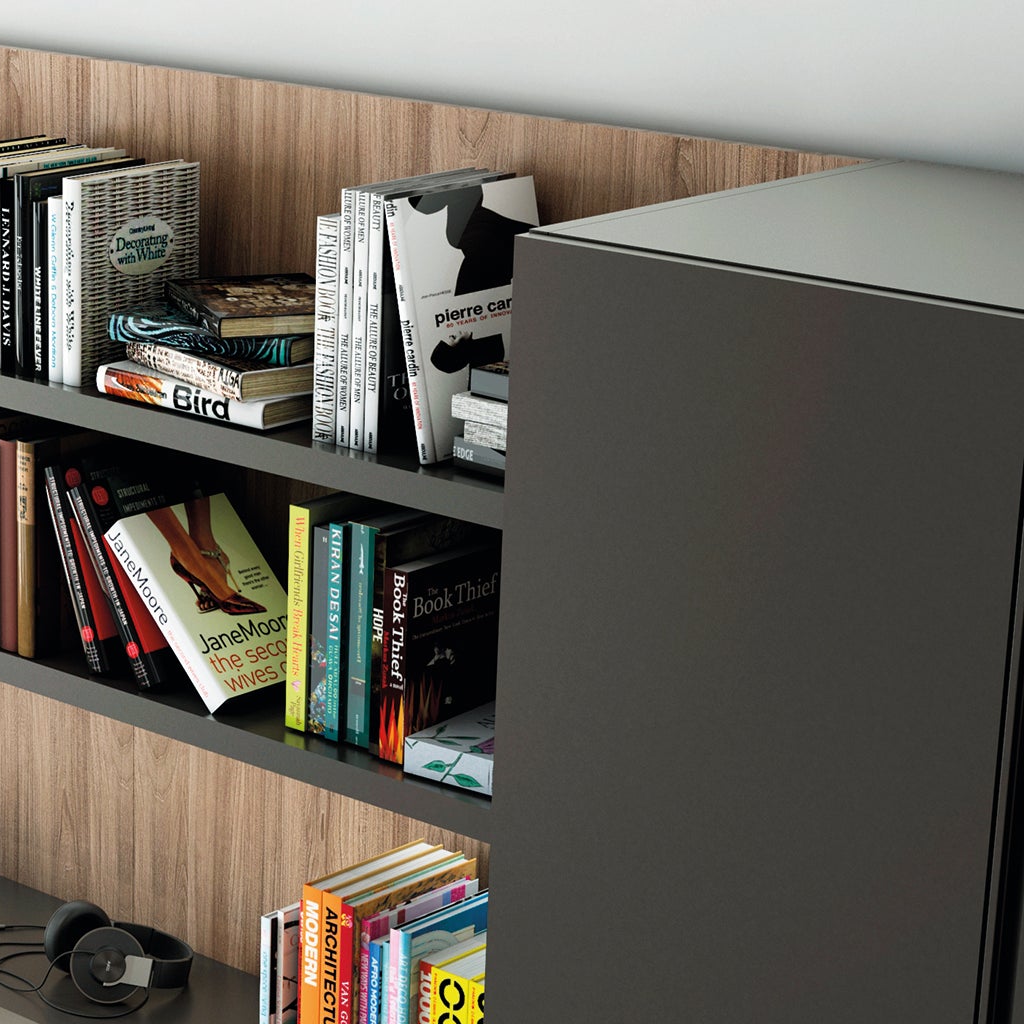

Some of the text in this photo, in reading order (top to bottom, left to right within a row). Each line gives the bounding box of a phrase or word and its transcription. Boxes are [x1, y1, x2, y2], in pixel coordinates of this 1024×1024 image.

[357, 216, 365, 243] OF MEN
[371, 200, 381, 232] BEAUTY
[116, 233, 169, 252] Decorating
[342, 225, 351, 253] WOMEN
[117, 246, 166, 265] with White
[317, 233, 338, 285] FASHION
[1, 208, 11, 346] LENNARD J. DAVIS
[317, 288, 336, 322] BOOK
[369, 303, 378, 319] THE
[434, 297, 513, 328] pierre car
[369, 320, 378, 349] ALLURE
[456, 318, 478, 327] YEARS
[317, 327, 336, 352] THE
[340, 333, 349, 346] THE
[354, 337, 362, 349] THE
[399, 319, 419, 377] pierre cardin
[340, 347, 349, 371] ALLURE
[354, 350, 362, 374] ALLURE
[315, 353, 336, 404] FASHION
[368, 362, 377, 393] BEAUTY
[172, 383, 231, 421] Bird
[339, 380, 348, 412] WOMEN
[353, 385, 361, 403] MEN
[314, 407, 333, 440] BOOK
[457, 447, 475, 461] EDGE
[49, 476, 62, 511] STRUCTURAL
[116, 482, 151, 499] STRUCTURAL
[75, 496, 90, 530] STRUCTURAL
[67, 549, 74, 558] TO
[69, 558, 81, 582] GROWTH
[101, 567, 108, 575] TO
[107, 533, 169, 626] JaneMoore
[104, 575, 118, 598] GROWTH
[291, 516, 305, 677] When Girlfriends Break Hearts
[329, 528, 342, 641] KIRAN DESAI
[412, 572, 498, 619] Book Thief
[76, 592, 86, 609] JAPAN
[116, 607, 128, 626] JAPAN
[372, 608, 384, 644] HOPE
[390, 572, 406, 682] Book Thief
[209, 639, 288, 674] the seco
[223, 665, 279, 693] wives
[289, 701, 297, 718] Page
[303, 899, 320, 987] MODERN
[360, 953, 369, 971] NEW
[370, 957, 378, 987] AFRO
[399, 953, 407, 972] ART
[340, 980, 350, 1007] VAN
[360, 971, 368, 992] WAYS
[397, 974, 407, 1004] DECO
[360, 992, 368, 1010] WITH
